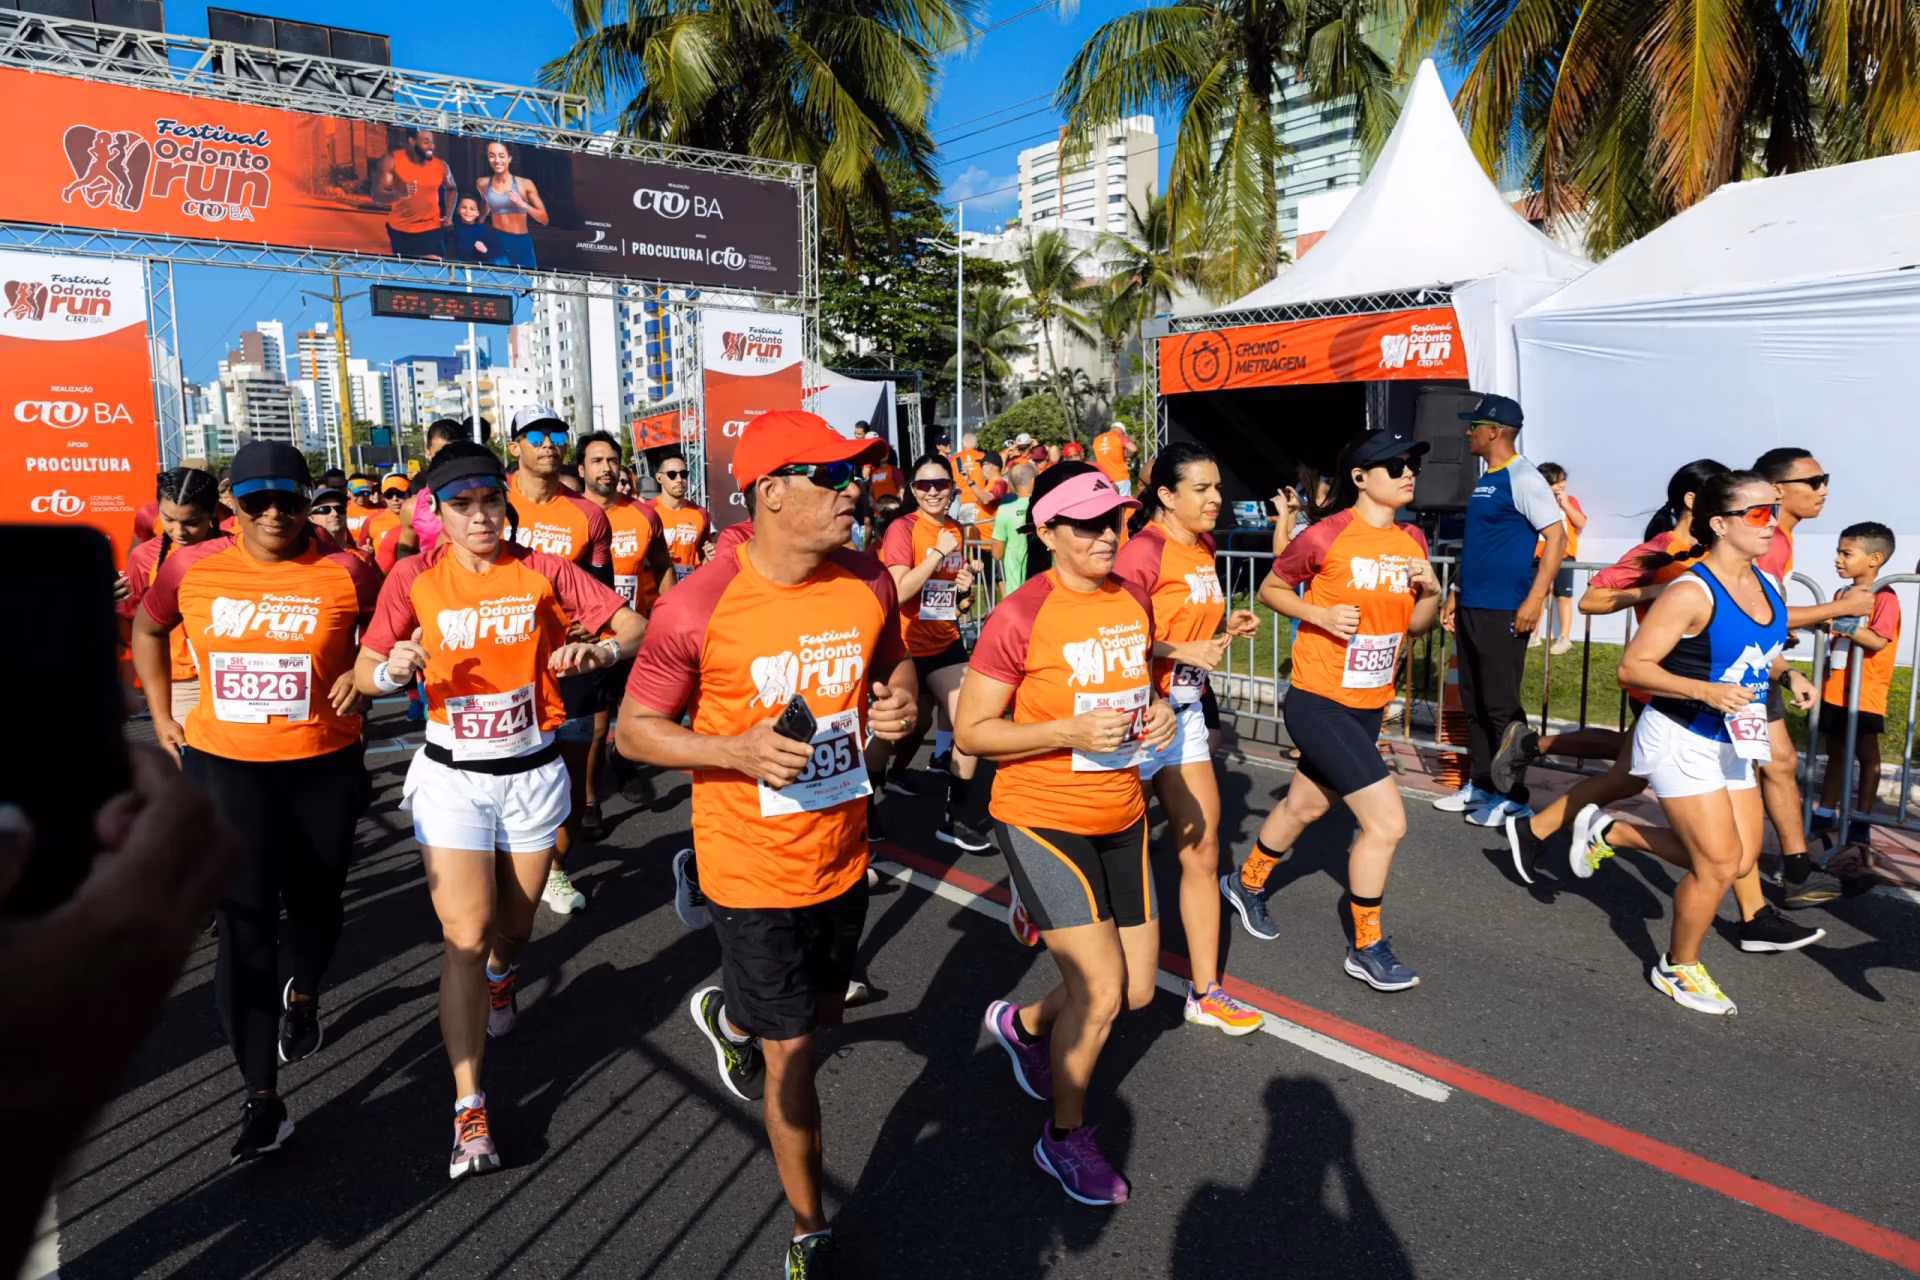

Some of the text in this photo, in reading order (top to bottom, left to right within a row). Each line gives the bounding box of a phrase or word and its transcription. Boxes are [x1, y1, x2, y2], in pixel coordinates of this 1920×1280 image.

[156, 118, 271, 148] Festival
[154, 138, 270, 171] Odonto
[150, 160, 271, 208] run
[230, 204, 255, 222] BA
[694, 195, 724, 219] BA
[632, 241, 703, 262] PROCULTURA
[51, 274, 111, 285] Festival
[50, 284, 111, 298] Odonto
[49, 295, 111, 316] run
[748, 326, 783, 335] Festival
[1410, 321, 1453, 333] Festival
[748, 334, 783, 344] Odonto
[1409, 332, 1452, 344] Odonto
[747, 343, 782, 358] run
[1406, 342, 1451, 360] run
[1235, 356, 1306, 374] METRAGEM
[51, 385, 93, 393] REALIZAÇÃO
[93, 401, 134, 425] BA
[26, 457, 131, 472] PROCULTURA
[533, 530, 571, 541] Odonto
[534, 522, 572, 534] Festival
[531, 537, 572, 555] run
[612, 534, 637, 542] donto
[262, 593, 322, 604] Festival
[479, 593, 533, 606] Festival
[926, 591, 952, 607] 5229
[257, 602, 319, 616] Odonto
[479, 603, 536, 617] Odonto
[249, 612, 318, 634] run
[479, 613, 535, 638] run
[1098, 620, 1142, 636] Festival
[291, 632, 304, 641] BA
[518, 633, 531, 642] BA
[799, 626, 859, 647] Festival
[1101, 632, 1146, 649] Odonto
[800, 642, 862, 663] Odonto
[1354, 648, 1393, 670] 5856
[800, 655, 863, 691] run
[222, 672, 298, 700] 5826
[1097, 698, 1110, 706] 5K
[462, 704, 528, 738] 5744
